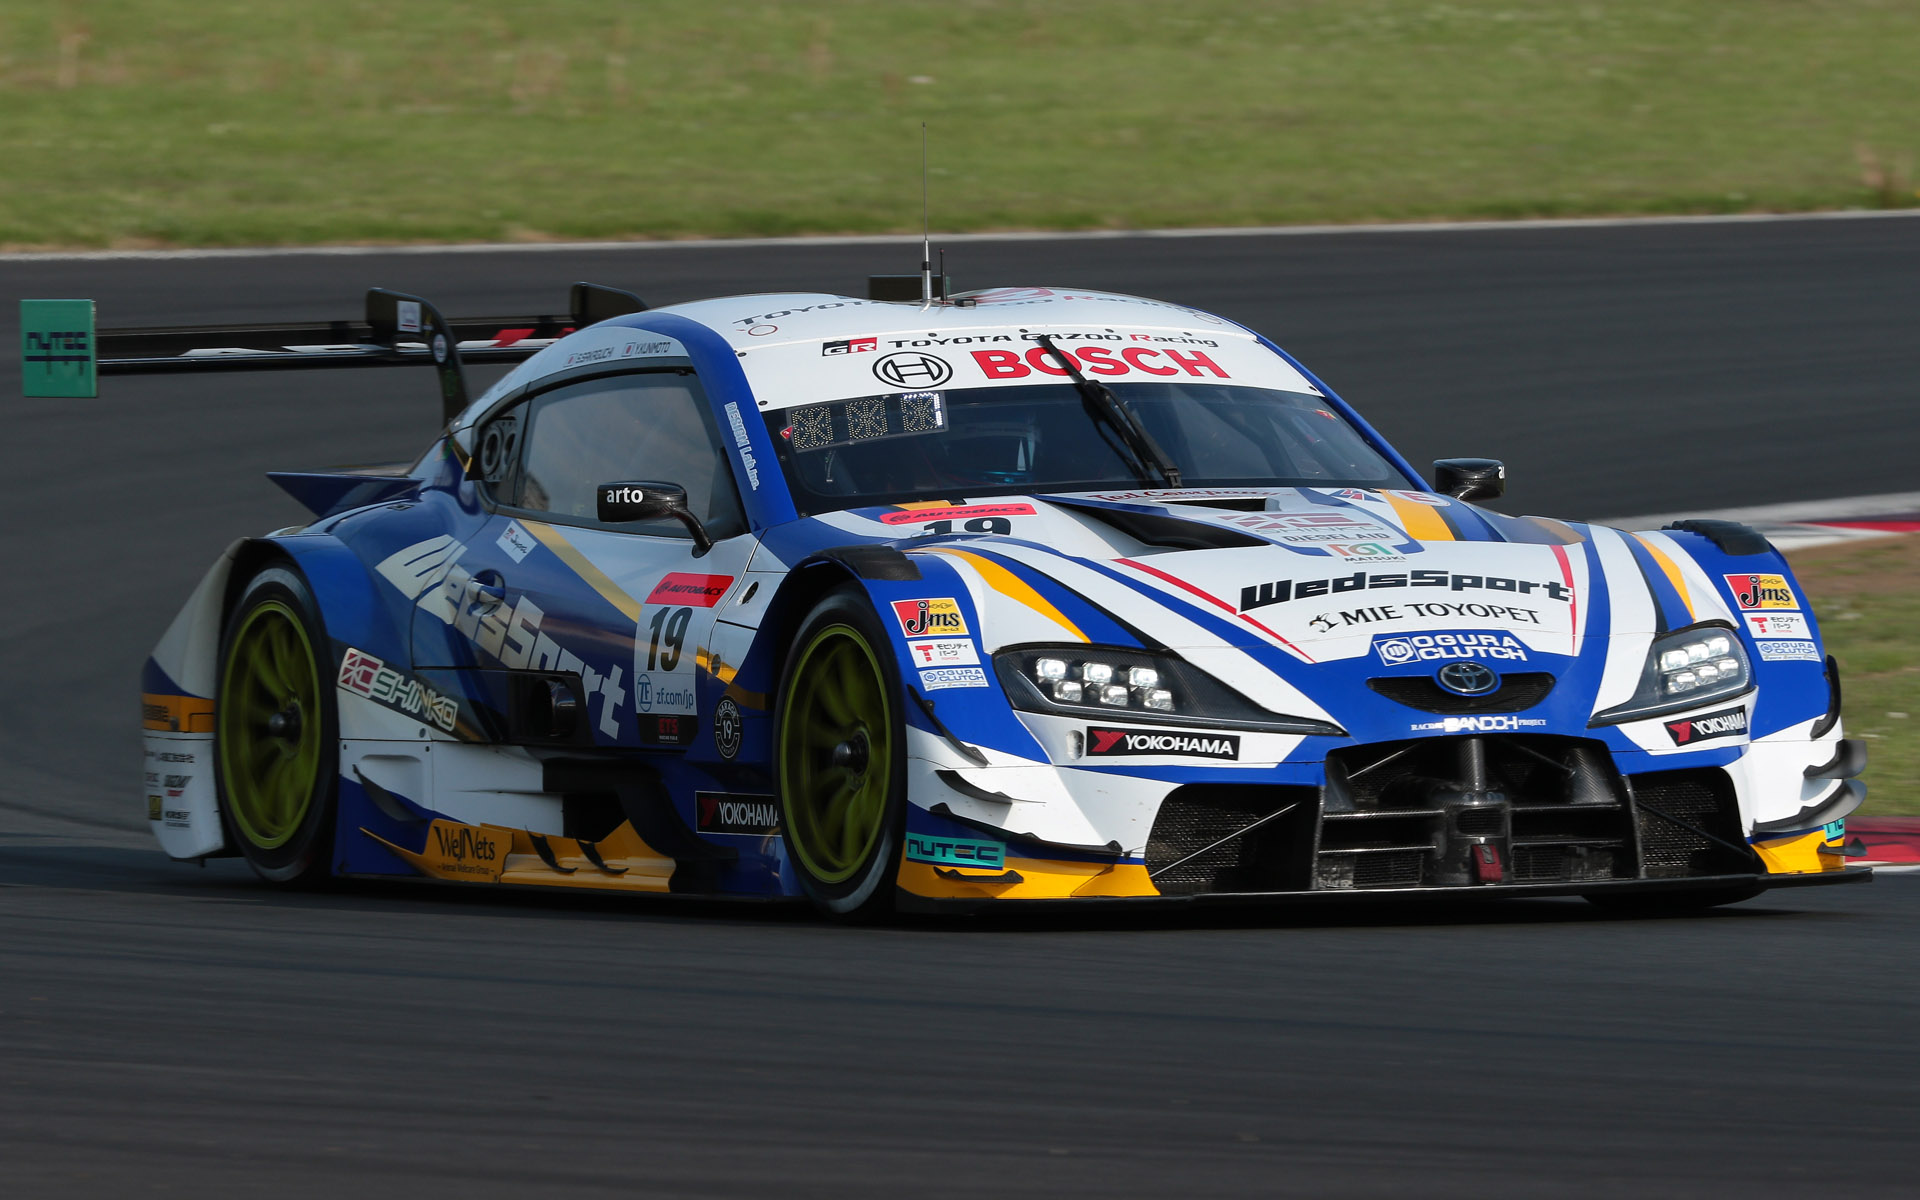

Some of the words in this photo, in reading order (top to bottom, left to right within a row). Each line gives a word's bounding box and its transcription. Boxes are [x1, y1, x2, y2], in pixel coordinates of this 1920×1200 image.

[888, 335, 1012, 349] TOYOTA
[1130, 333, 1218, 348] Racing
[970, 347, 1231, 379] BOSCH
[724, 401, 750, 448] DESIGN
[739, 447, 757, 470] Lab
[606, 487, 644, 503] arto
[913, 506, 1027, 519] AUTOBACS
[924, 517, 1012, 536] 19
[1283, 533, 1347, 542] DIESEL
[668, 583, 724, 597] AUTOBACS
[1240, 570, 1573, 613] WedsSport
[1740, 575, 1791, 608] jms
[905, 600, 960, 635] jms
[1339, 604, 1403, 627] MIE
[1405, 603, 1542, 625] TOYOPET
[646, 606, 694, 672] 19
[1411, 634, 1521, 649] OGURA
[1417, 647, 1528, 661] CLUTCH
[937, 669, 983, 677] OGURA
[371, 667, 459, 731] SHINKO
[637, 681, 653, 705] ZF
[656, 688, 694, 709] zf.com/jp
[658, 718, 679, 734] ETS
[722, 719, 733, 740] 19
[1443, 716, 1519, 732] BANDOH
[1691, 711, 1746, 735] YOKOHAMA
[1125, 734, 1234, 755] YOKOHAMA
[433, 826, 496, 861] WellNets
